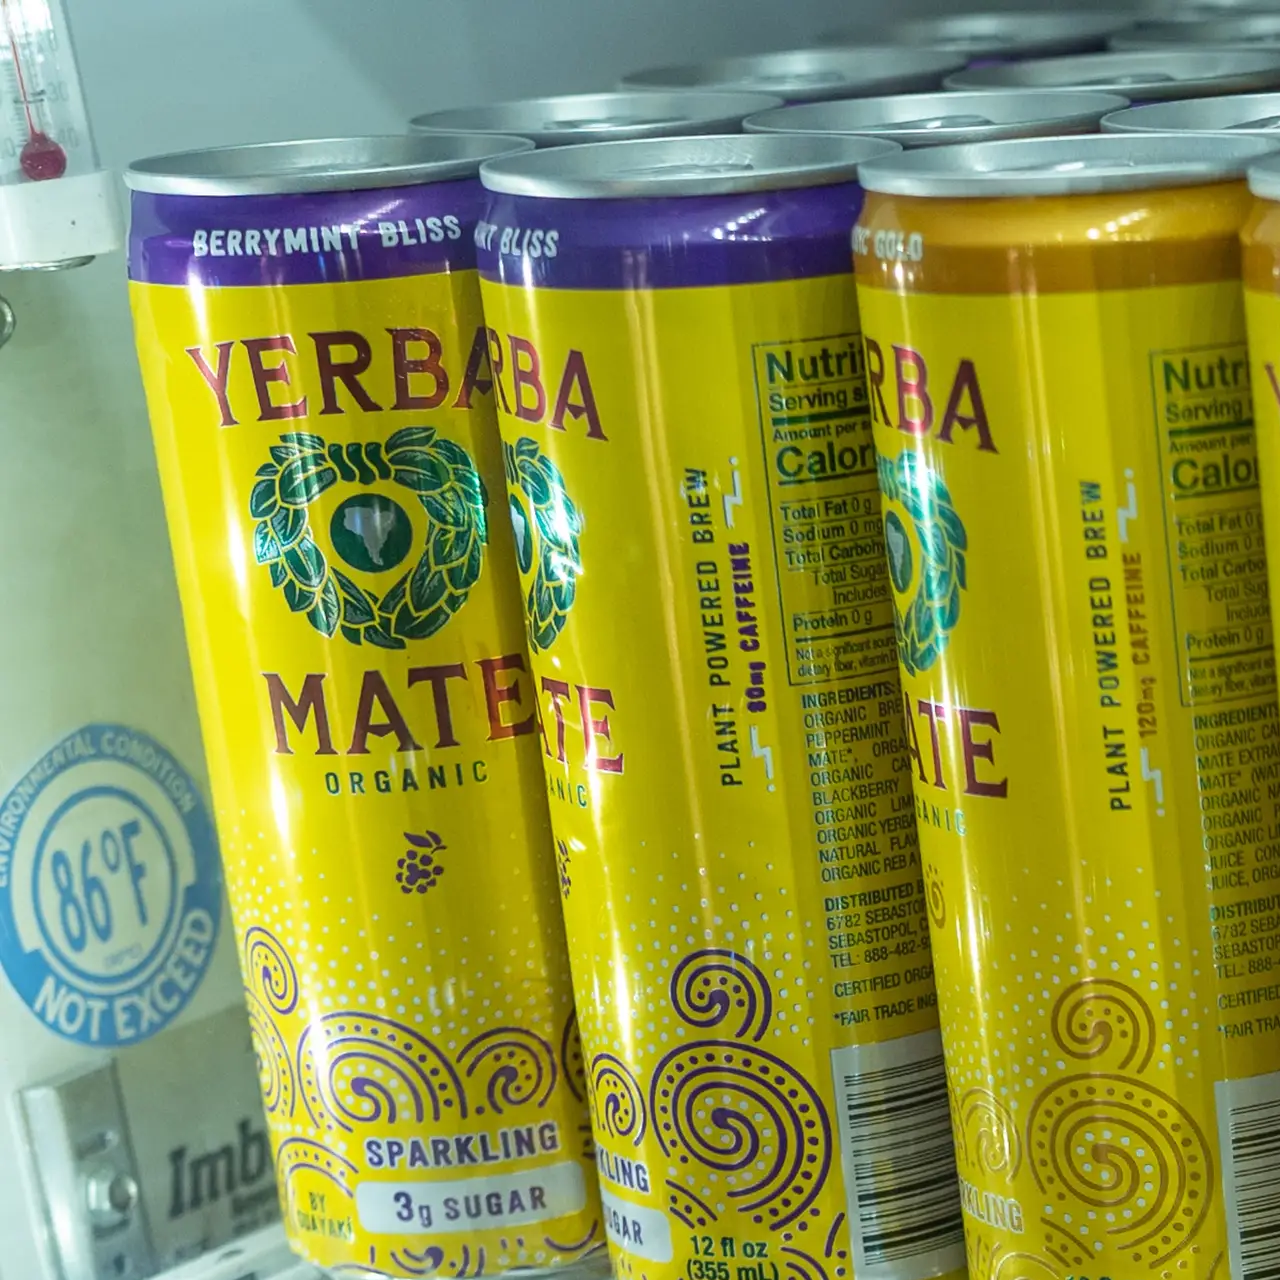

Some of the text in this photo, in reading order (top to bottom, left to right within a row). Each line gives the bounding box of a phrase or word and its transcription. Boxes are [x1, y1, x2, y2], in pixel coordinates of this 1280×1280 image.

[192, 225, 360, 259] BERRYMINT
[379, 215, 463, 247] BLISS
[500, 227, 559, 259] BLISS
[185, 326, 492, 429] YERBA
[768, 387, 848, 413] Serving
[772, 422, 856, 443] Amount per
[780, 500, 849, 523] Total Fat
[783, 526, 845, 543] Sodium
[785, 550, 825, 567] Total
[811, 567, 847, 585] Total
[1122, 552, 1150, 665] CAFFEINE
[684, 467, 743, 788] PLANT POWERED BREW
[792, 613, 848, 632] Protein
[1080, 481, 1132, 810] PLANT POWERED BREW
[261, 652, 540, 757] MATE
[801, 681, 896, 709] INGREDIENTS:
[803, 704, 867, 729] ORGANIC
[806, 725, 890, 749] PEPPERMINT
[325, 759, 489, 796] ORGANIC
[812, 782, 900, 806] BLACKBERRY
[819, 843, 881, 863] NATURAL
[824, 883, 914, 912] DISTRIBUTED
[826, 915, 862, 931] 6782
[33, 909, 214, 1041] NOT EXCEED
[834, 971, 902, 998] CERTIFIED
[874, 1002, 916, 1021] TRADE
[364, 1120, 559, 1170] SPARKLING
[393, 1186, 548, 1228] 3g SUGAR
[690, 1235, 768, 1258] 12 fl oz
